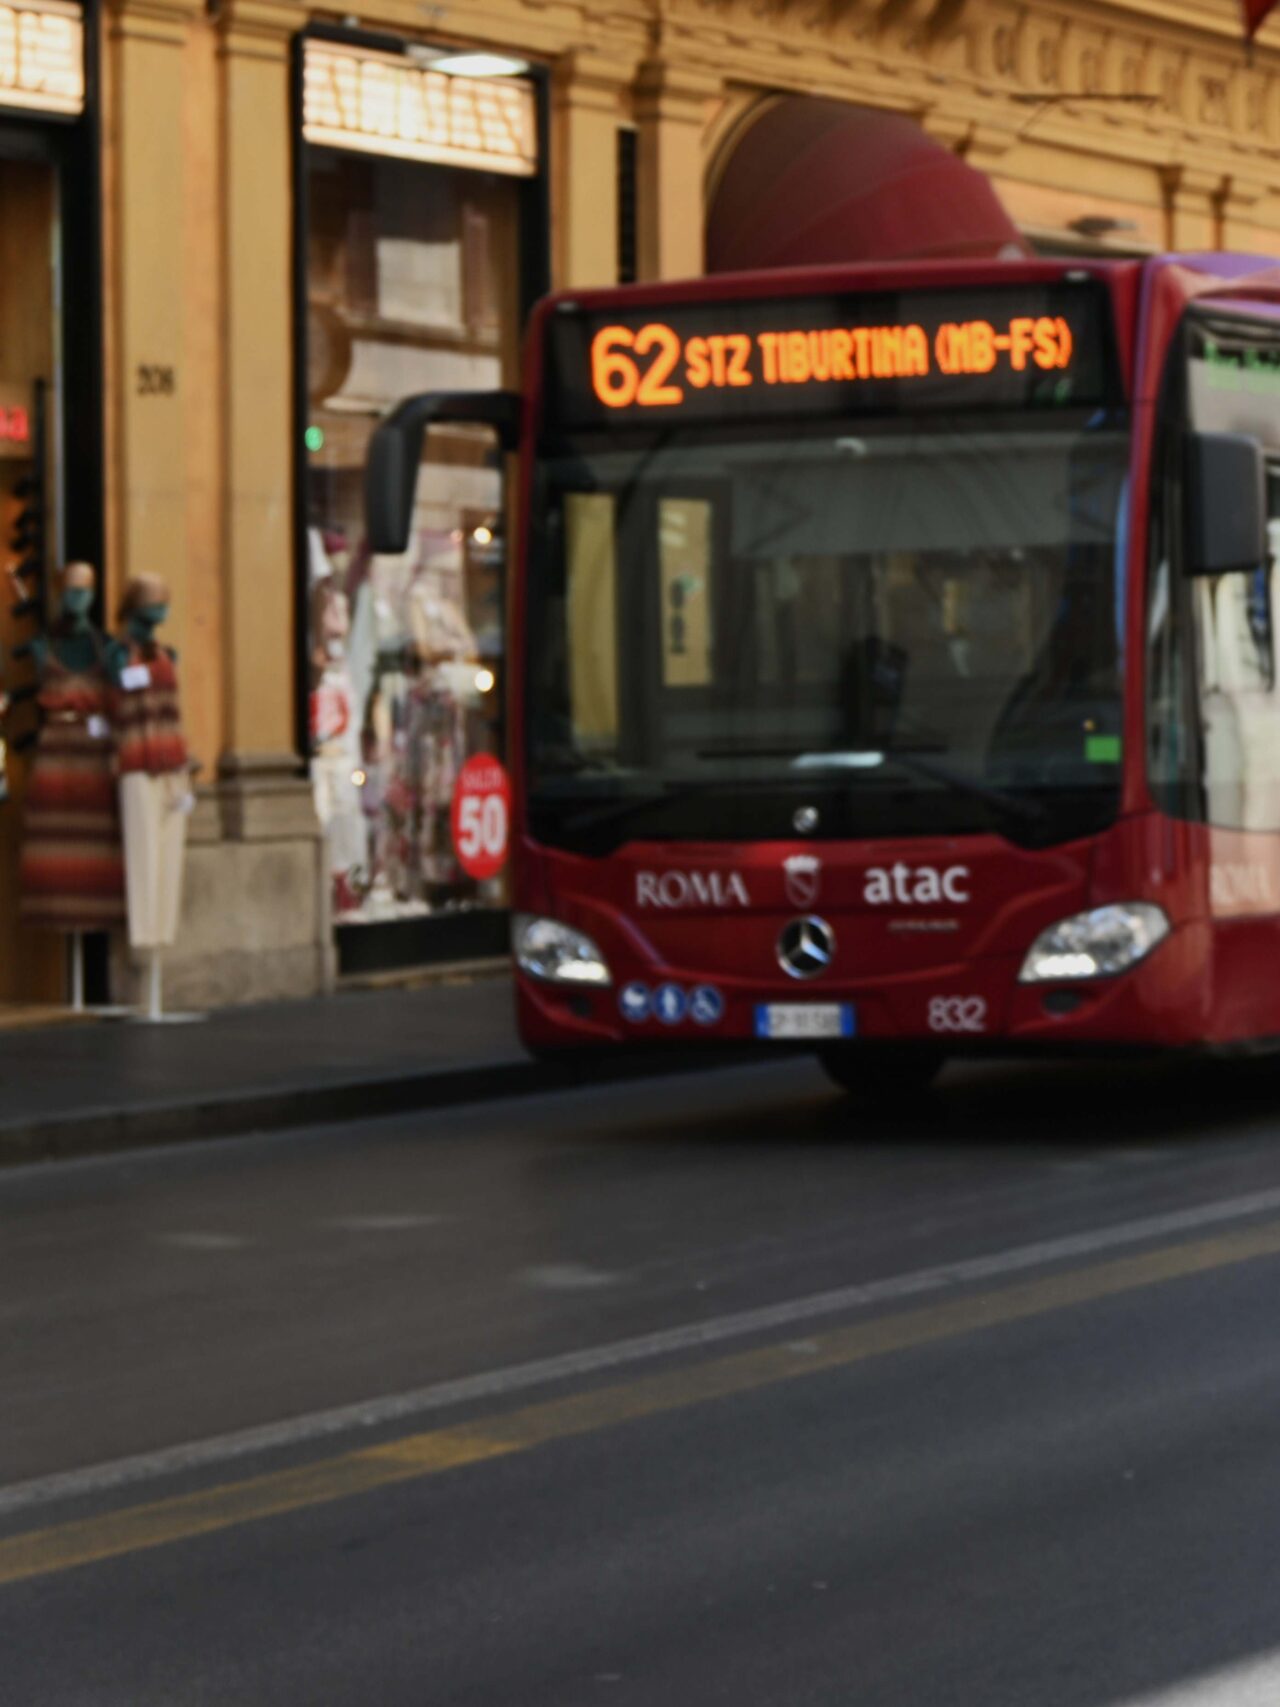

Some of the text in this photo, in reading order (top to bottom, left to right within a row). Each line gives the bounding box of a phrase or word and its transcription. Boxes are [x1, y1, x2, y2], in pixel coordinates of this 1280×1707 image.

[591, 323, 683, 408] 62
[685, 334, 752, 388] STZ
[757, 323, 930, 384] TIBURTINA
[459, 795, 507, 857] 50
[635, 871, 750, 907] ROMA
[863, 861, 970, 903] atac
[928, 995, 987, 1031] 832
